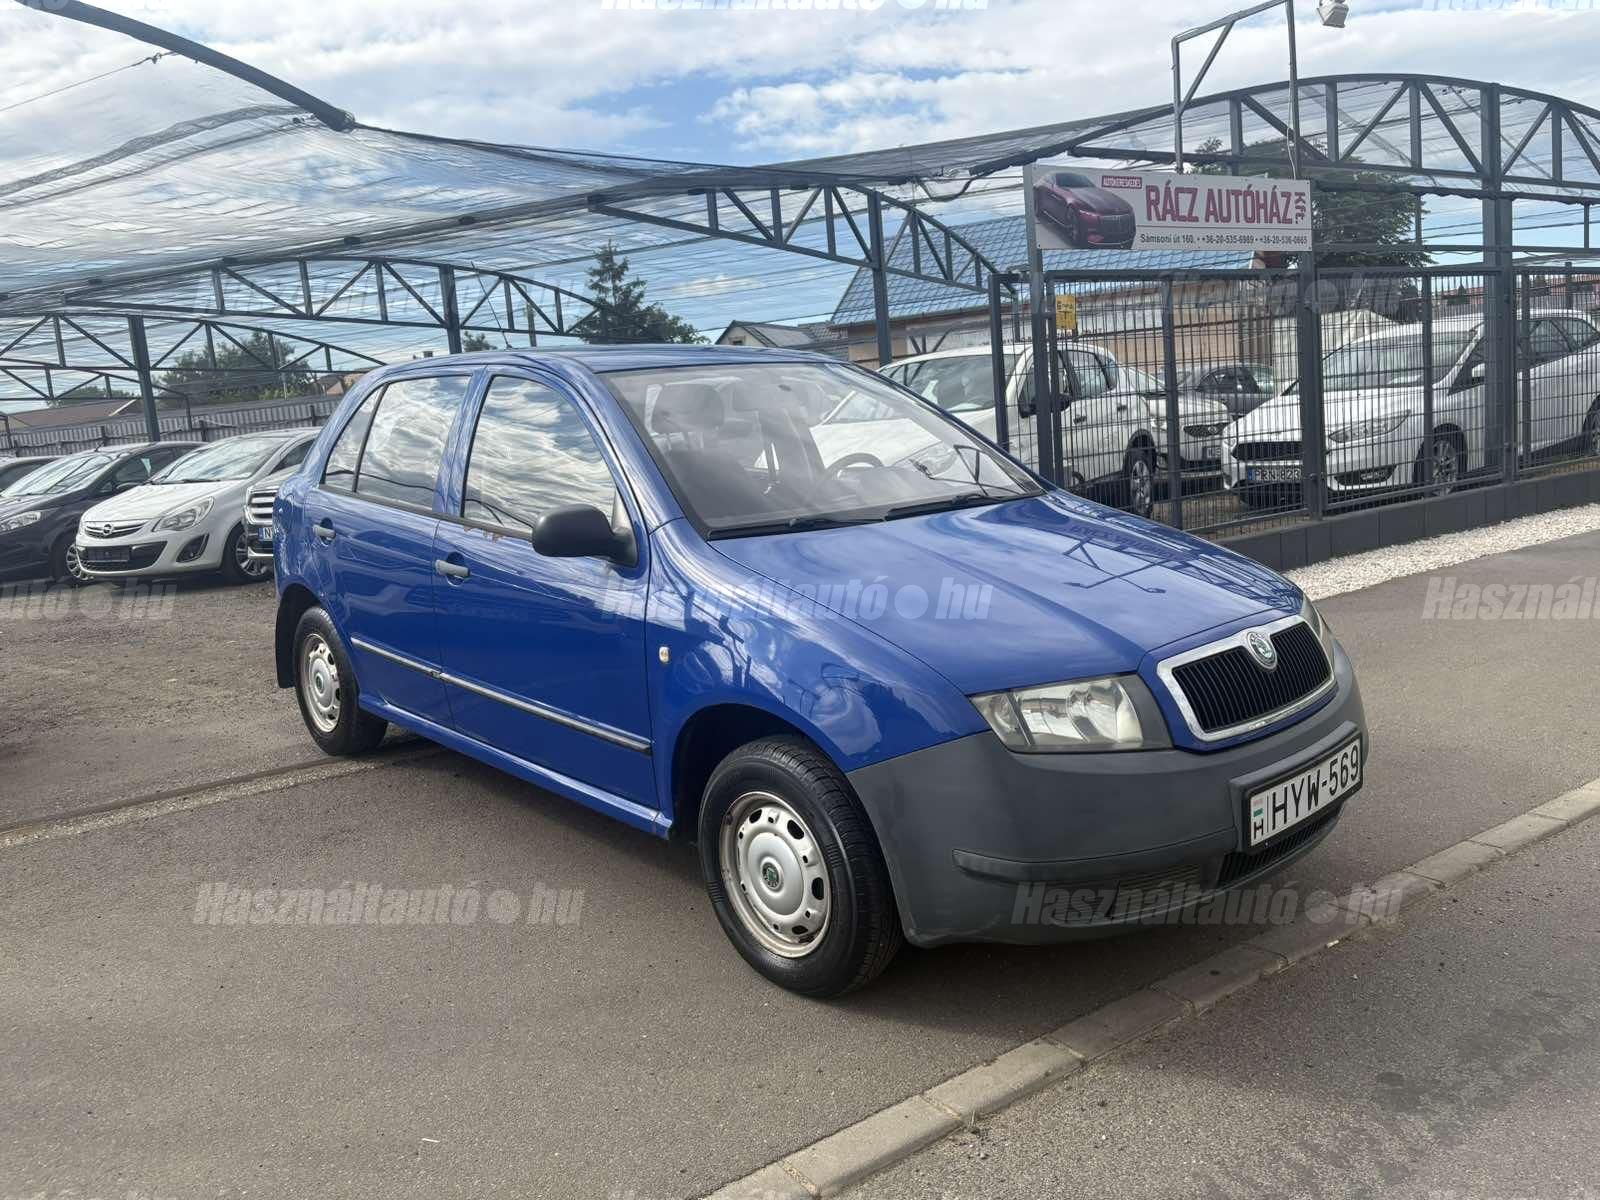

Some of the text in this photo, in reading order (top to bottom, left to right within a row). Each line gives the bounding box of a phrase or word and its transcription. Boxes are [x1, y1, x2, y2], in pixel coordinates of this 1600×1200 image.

[1145, 179, 1293, 225] RÁCZ AUTÓHÁZ
[1294, 191, 1306, 225] Kft.
[1272, 745, 1359, 830] HYW-569
